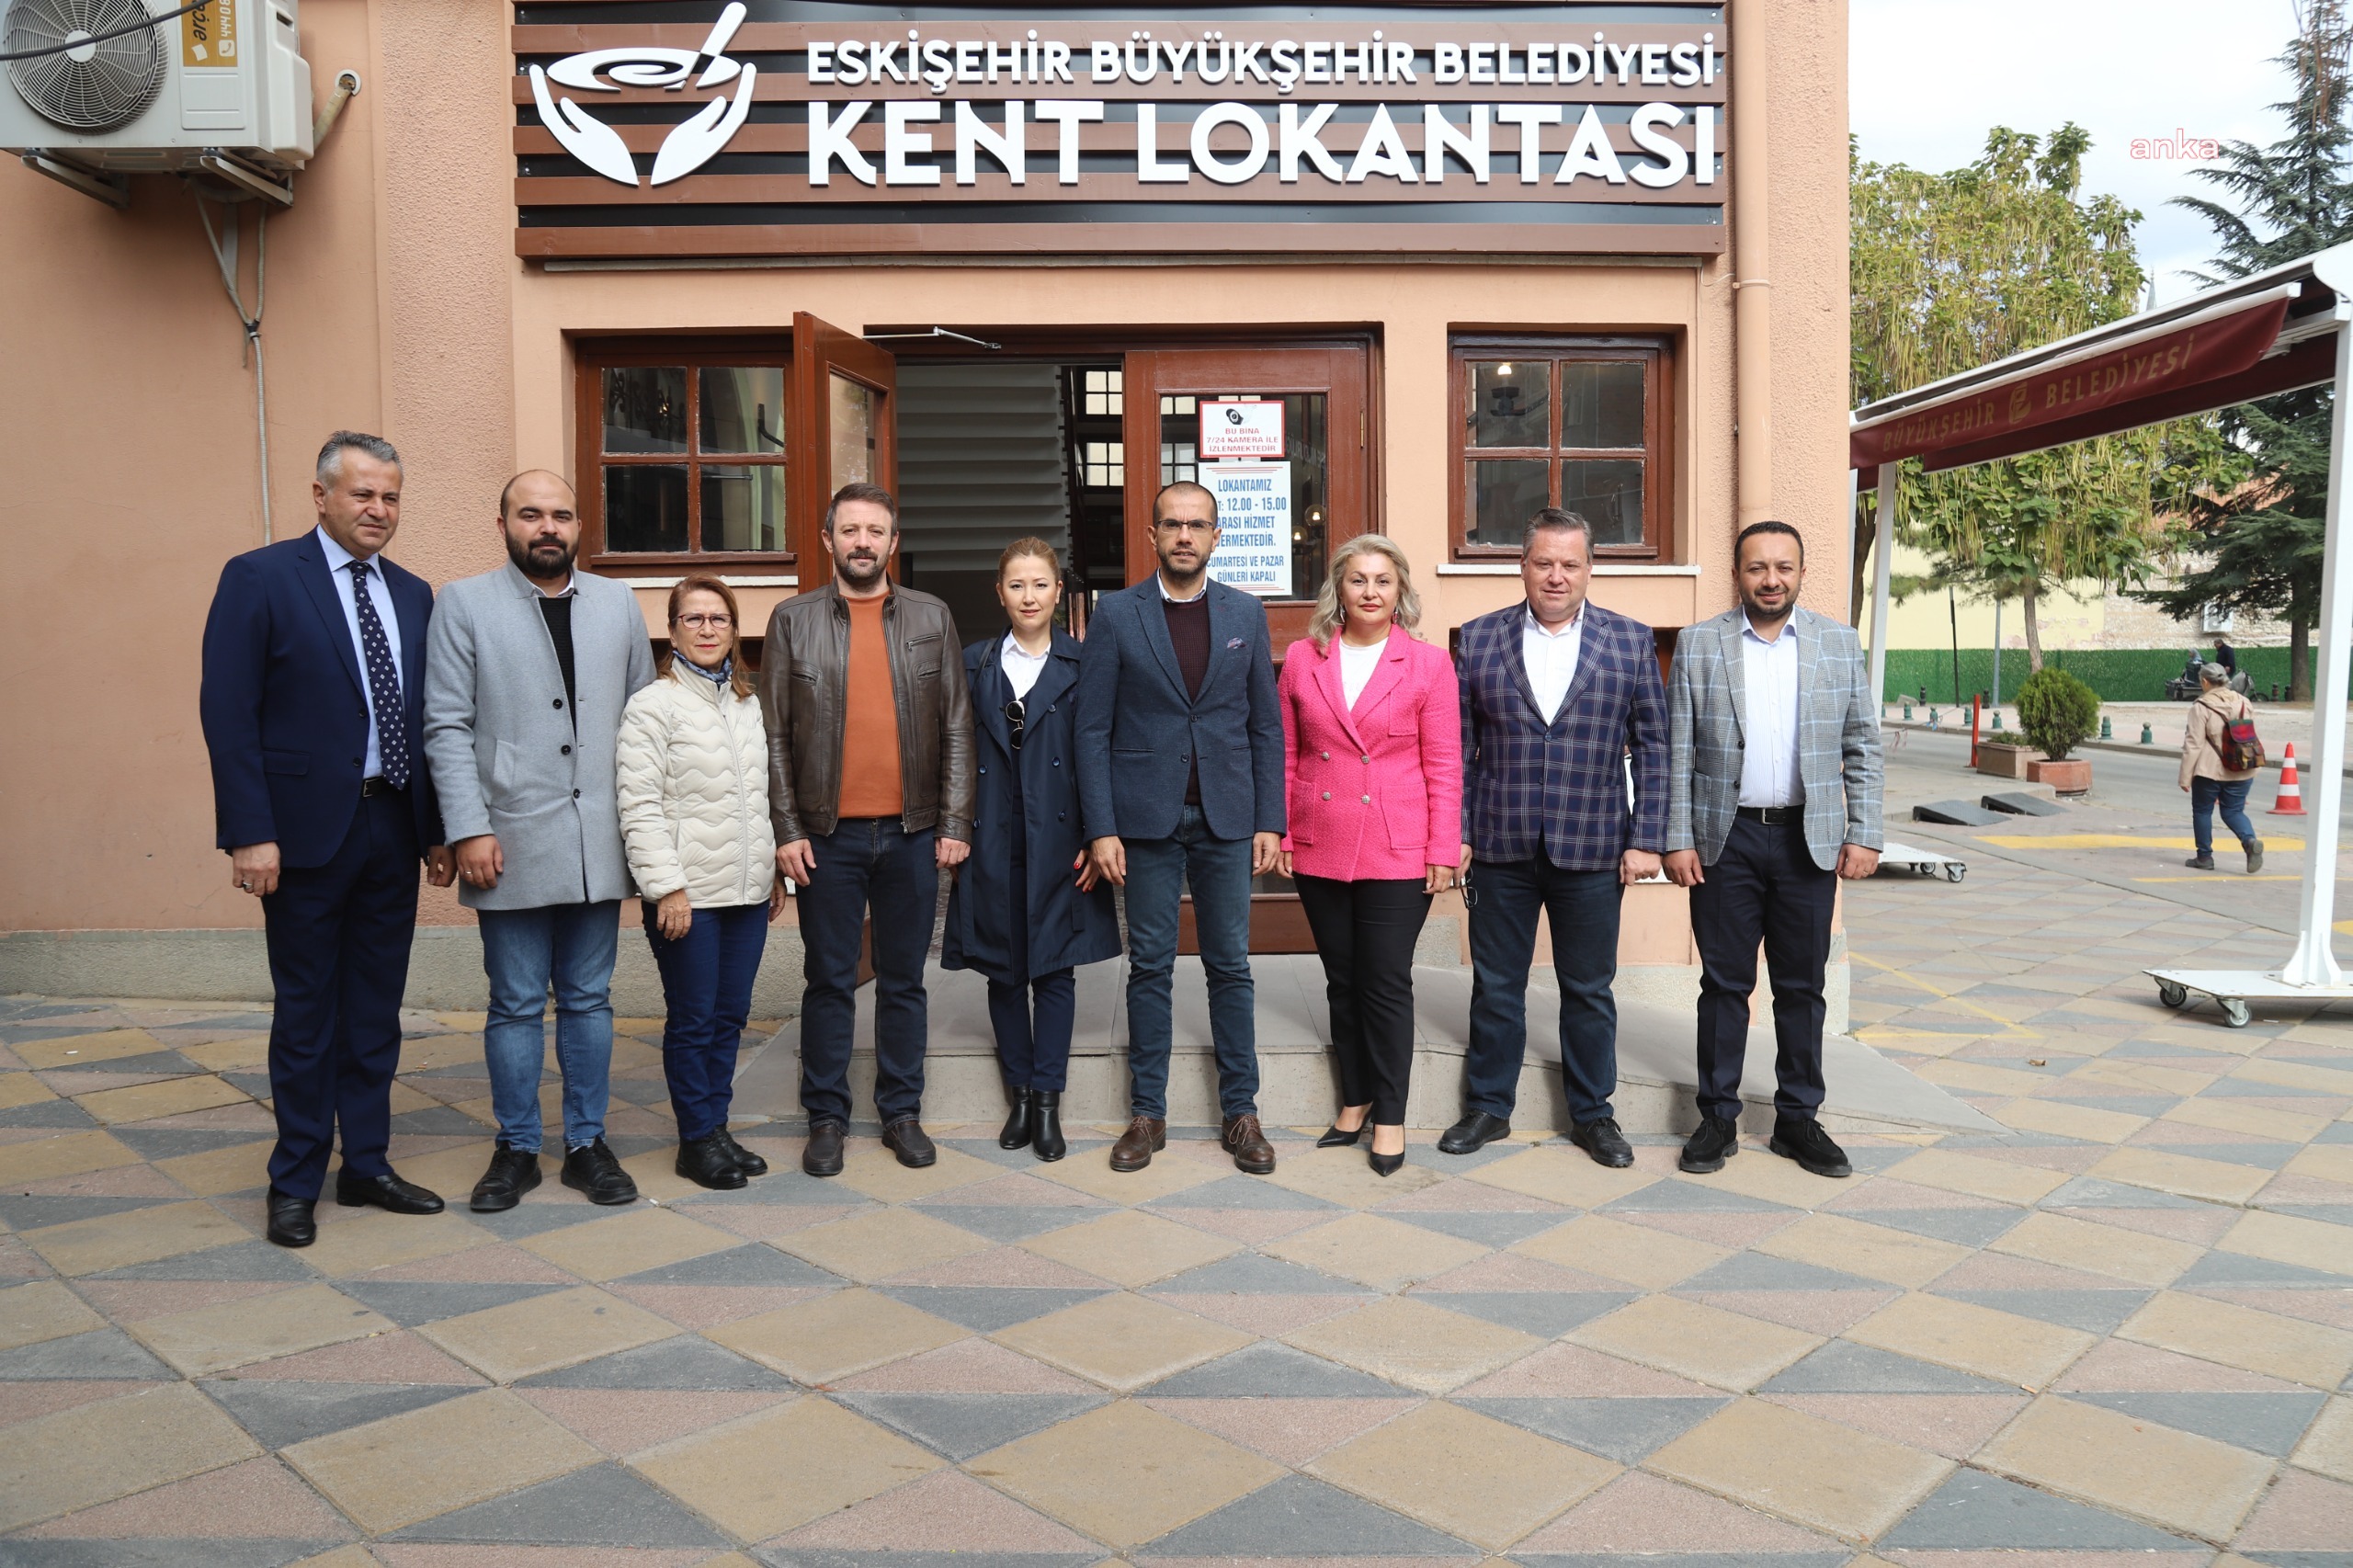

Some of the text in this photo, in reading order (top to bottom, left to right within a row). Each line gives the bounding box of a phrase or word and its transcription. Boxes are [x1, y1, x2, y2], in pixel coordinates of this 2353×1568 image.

[808, 29, 1715, 94] ESKİŞEHİR BÜYÜKŞEHİR BELEDİYESİ
[808, 100, 1715, 187] KENT LOKANTASI
[1883, 333, 2195, 452] BÜYÜKŞEHİR BELEDİYESİ
[1239, 426, 1260, 435] BİNA
[1266, 435, 1279, 443] İLE
[1209, 444, 1276, 452] İZLENMEKTEDİR
[1218, 479, 1272, 492] LOKANTAMIZ
[1226, 497, 1252, 511] 12.00
[1261, 496, 1287, 511] 15.00
[1217, 513, 1275, 528] ARASI HİZMET
[1250, 555, 1258, 567] VE
[1260, 555, 1284, 566] PAZAR
[1217, 569, 1276, 582] GÜNLERİ KAPALI
